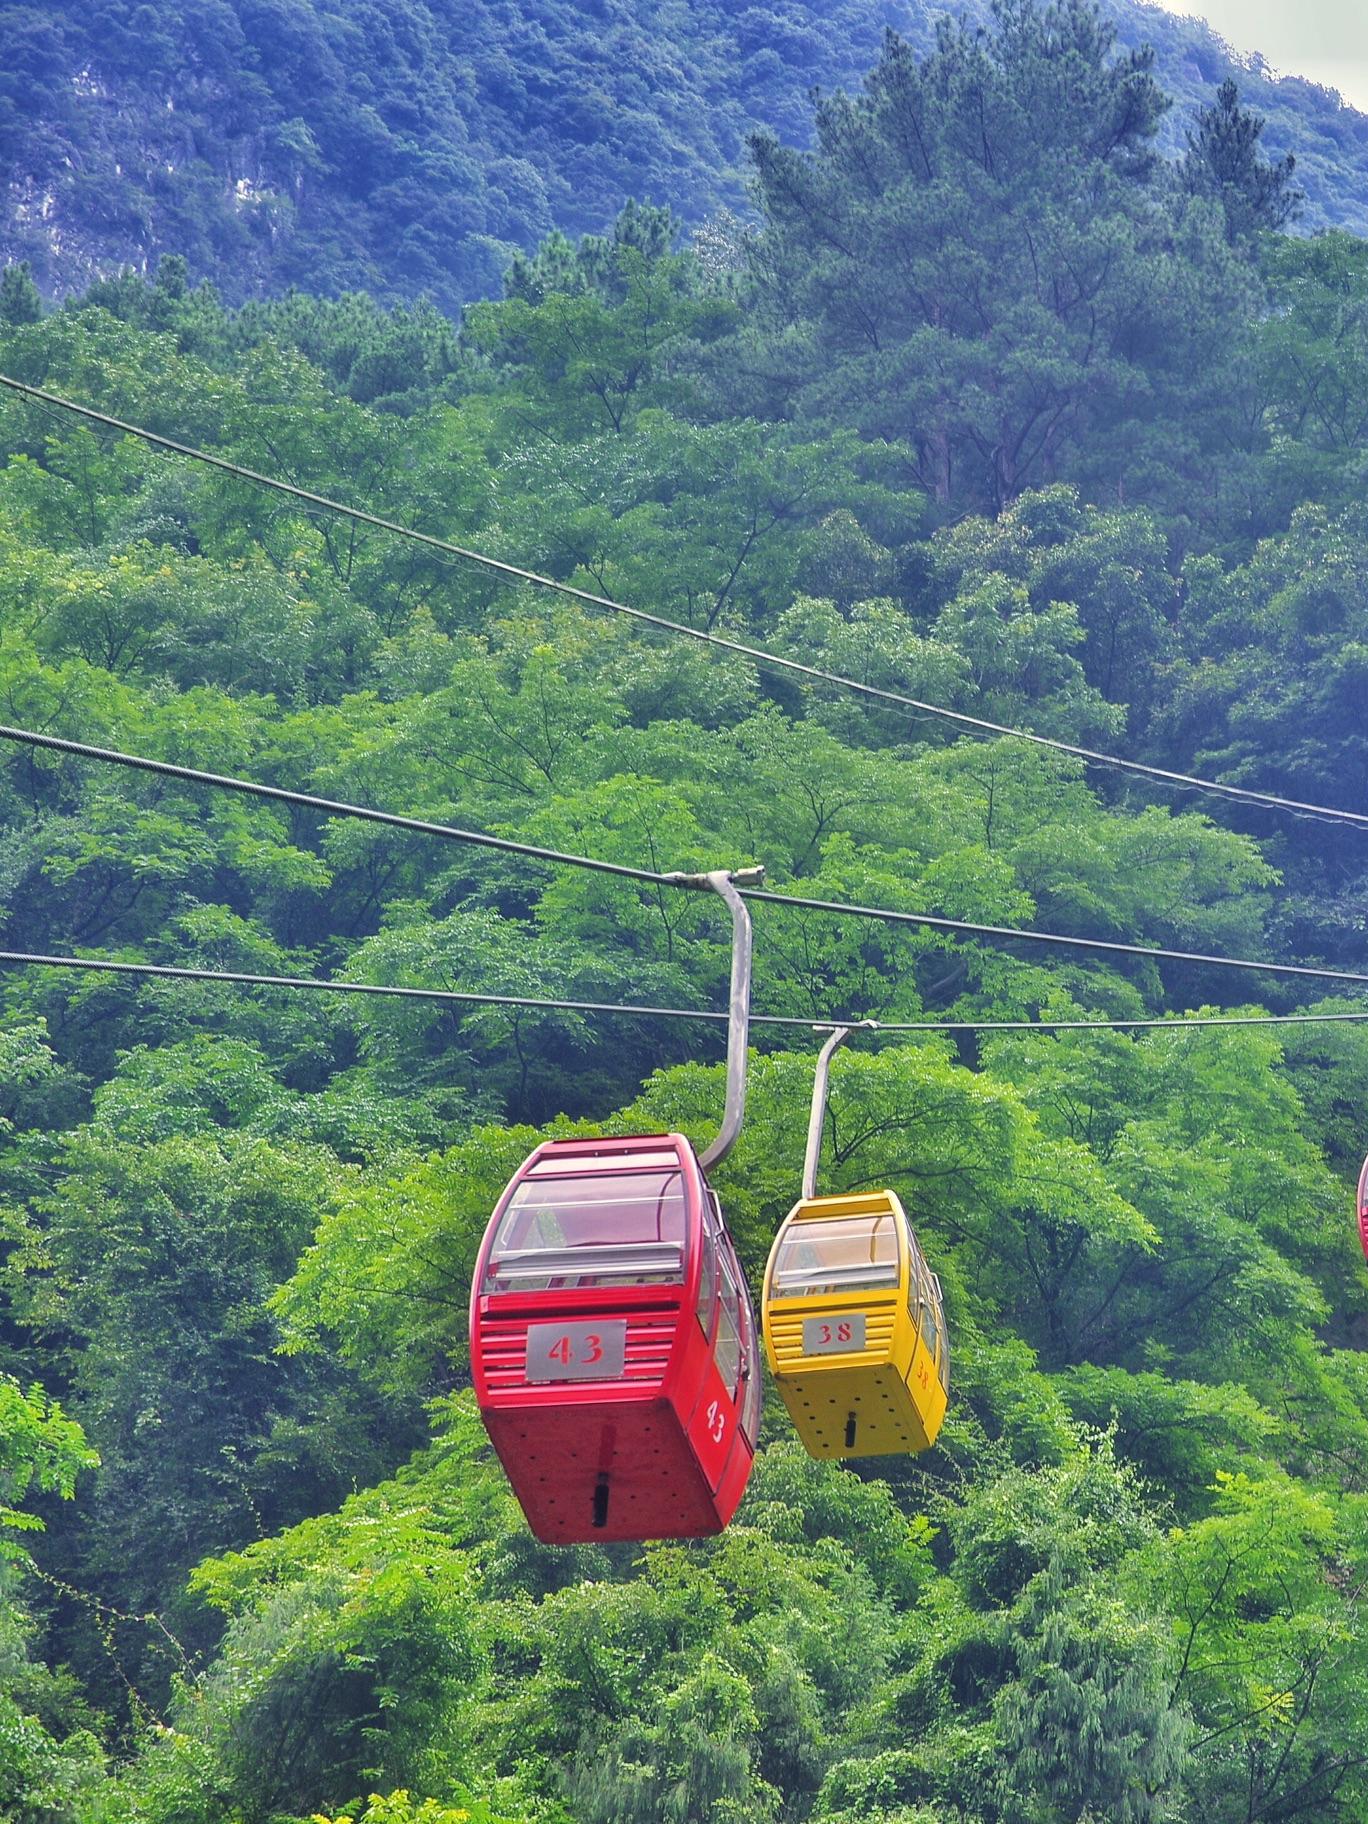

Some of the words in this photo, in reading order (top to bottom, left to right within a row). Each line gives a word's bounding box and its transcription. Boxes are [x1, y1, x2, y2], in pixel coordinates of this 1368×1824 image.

[817, 1322, 854, 1345] 38
[548, 1335, 605, 1366] 43
[917, 1359, 929, 1391] 38
[706, 1400, 725, 1444] 43
